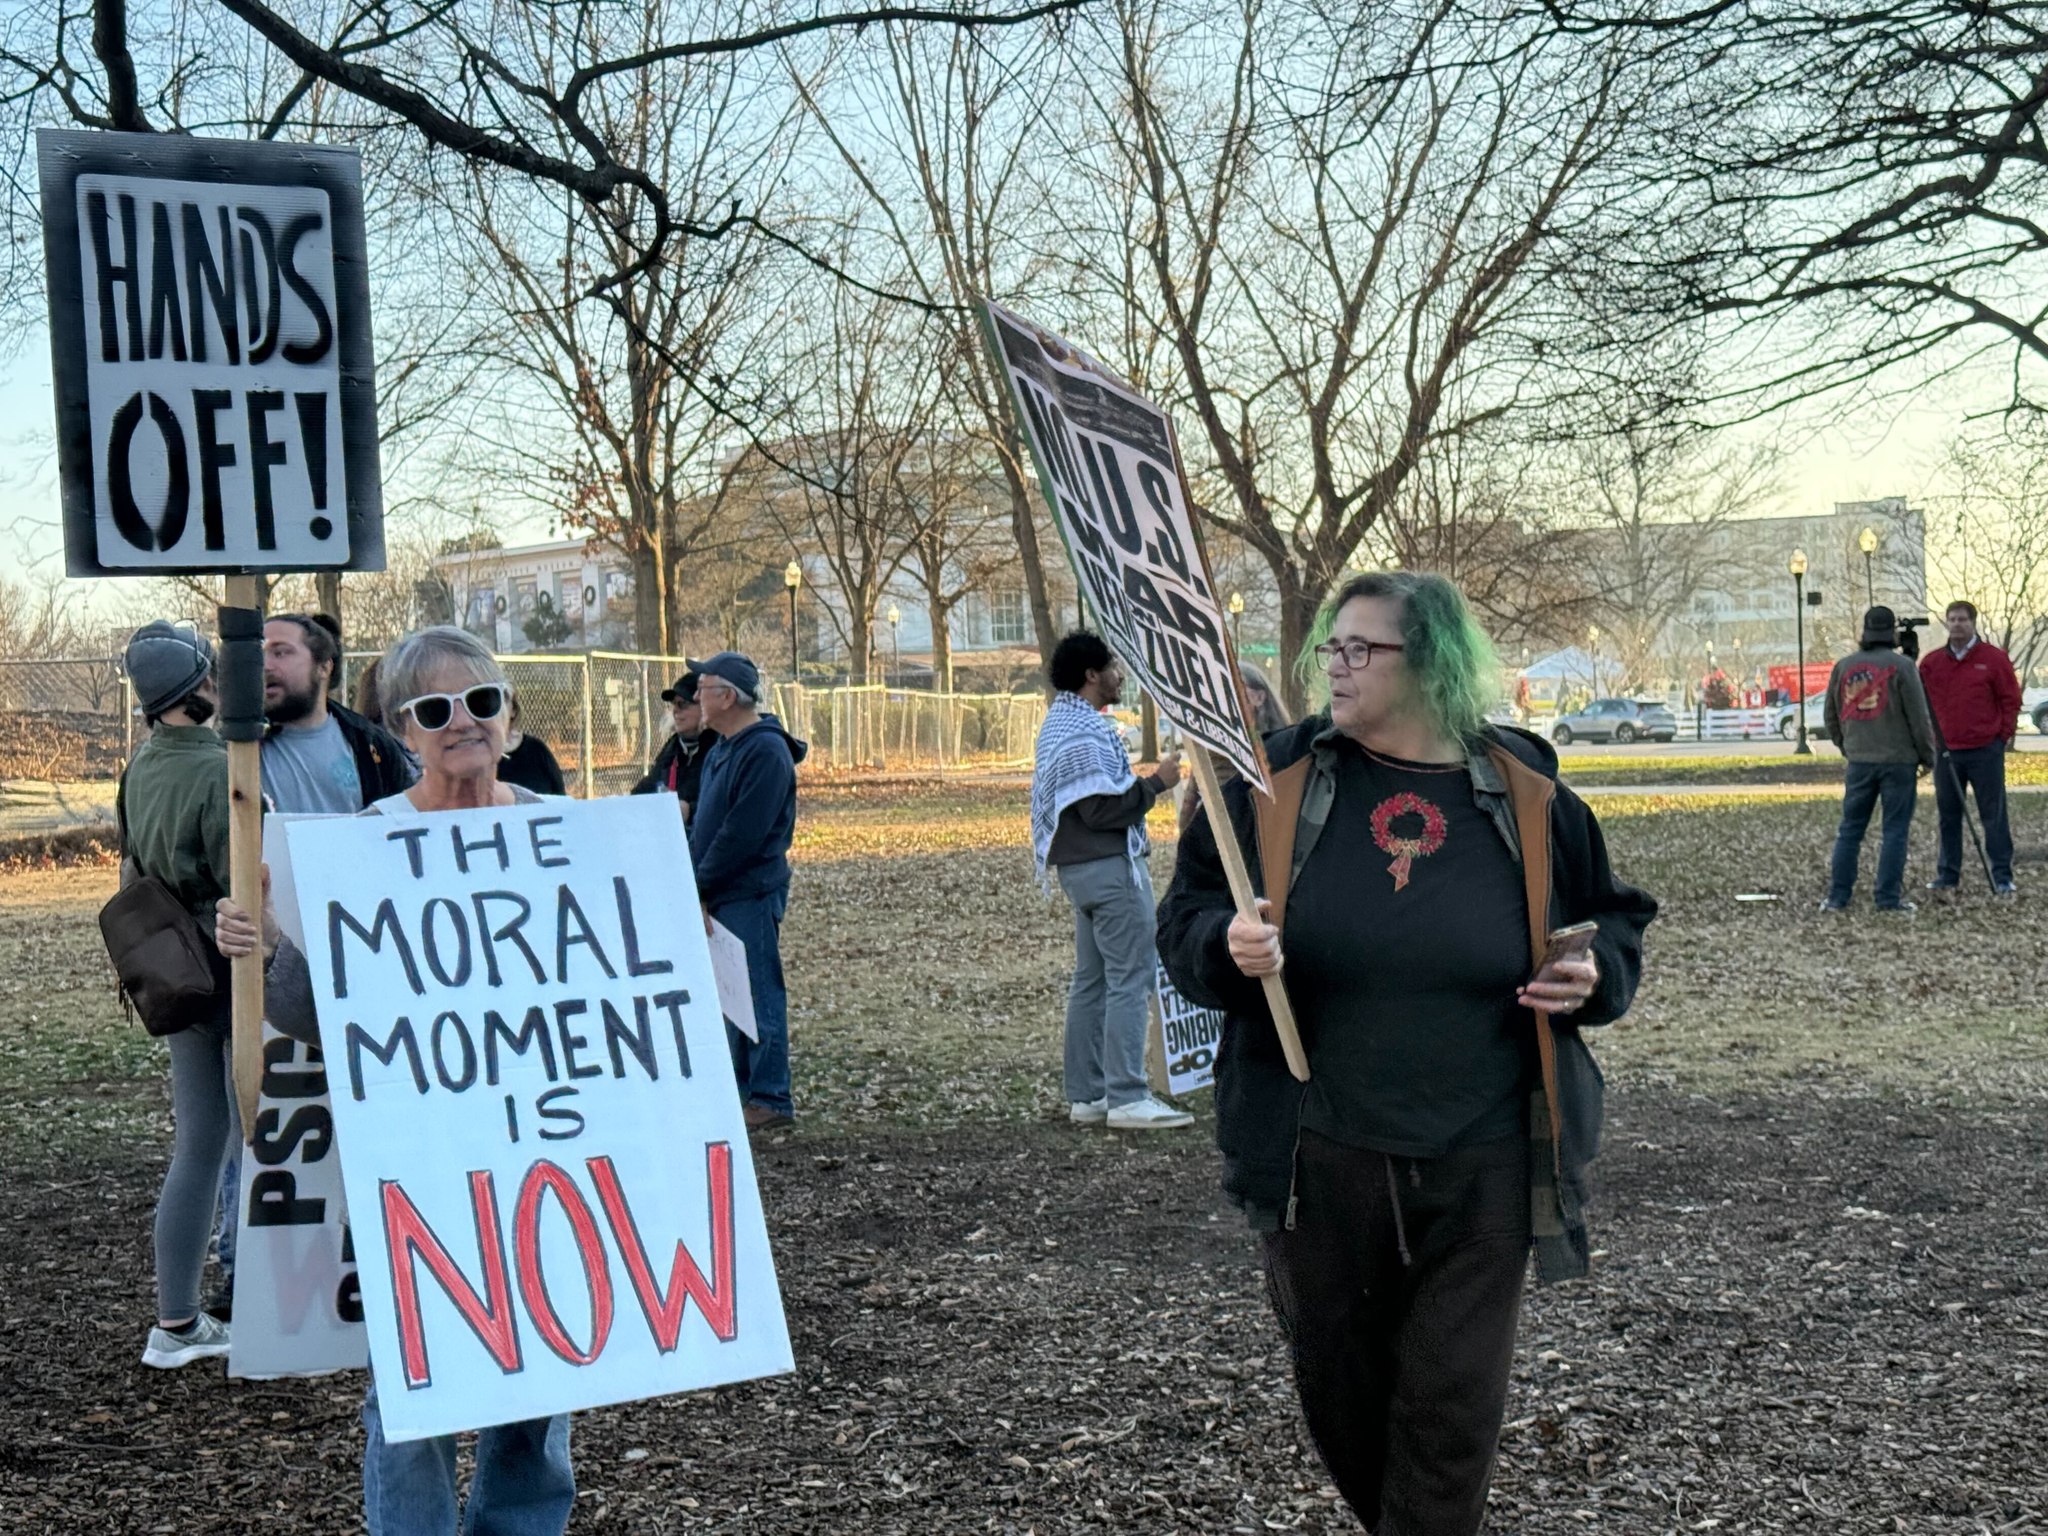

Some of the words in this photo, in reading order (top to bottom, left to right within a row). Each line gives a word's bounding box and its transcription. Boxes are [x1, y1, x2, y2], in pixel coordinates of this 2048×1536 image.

[87, 191, 332, 365] HANDS
[107, 389, 333, 552] OFF!
[1016, 375, 1099, 525] NO
[1076, 431, 1211, 601] U.S.
[1060, 495, 1229, 674] WAR
[1076, 550, 1250, 743] VENZUELA
[387, 815, 572, 879] THE
[328, 876, 673, 999] MORAL
[345, 989, 692, 1101] MOMENT
[505, 1086, 585, 1143] IS
[378, 1140, 738, 1391] NOW
